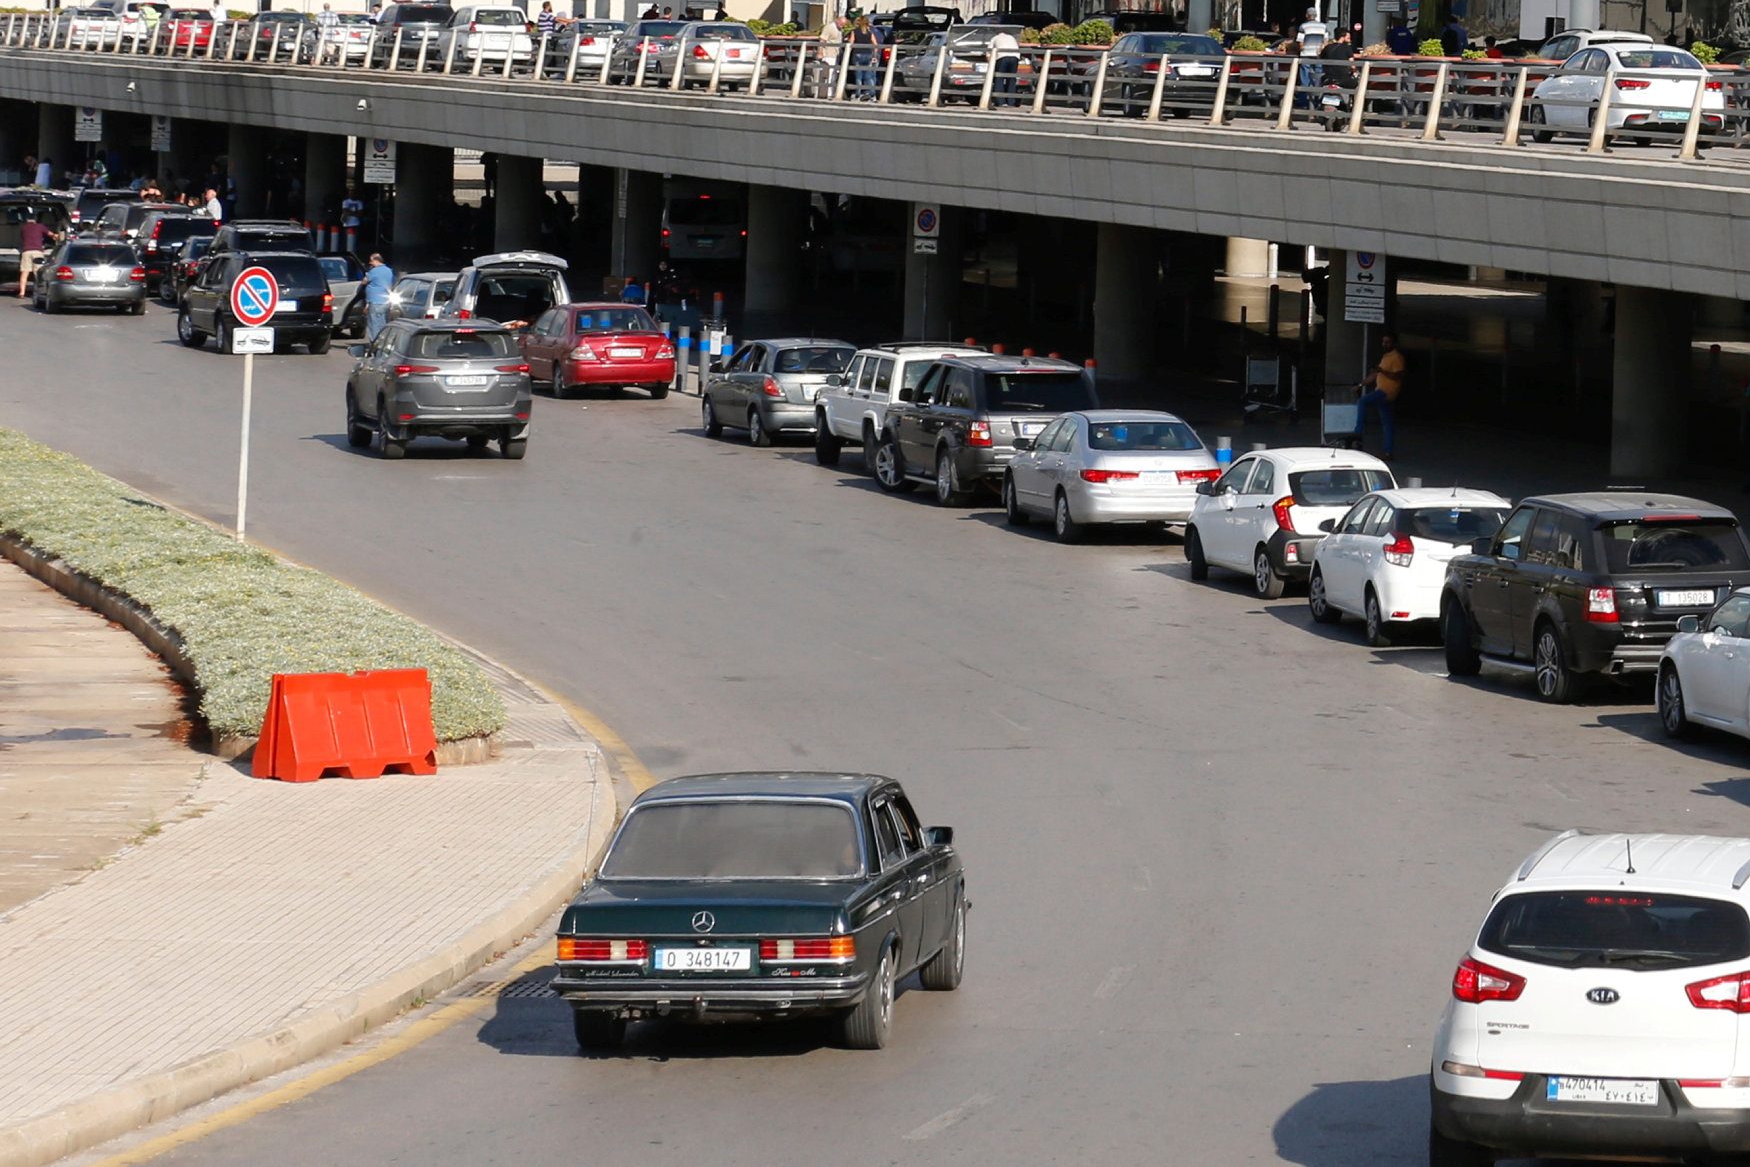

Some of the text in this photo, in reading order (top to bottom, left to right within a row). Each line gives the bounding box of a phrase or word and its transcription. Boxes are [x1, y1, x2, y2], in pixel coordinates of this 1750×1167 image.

[1678, 593, 1708, 603] 135028
[686, 951, 740, 967] 348147
[1590, 990, 1616, 1002] KIA
[1486, 1021, 1530, 1030] SPORTAGE
[1565, 1077, 1606, 1091] 470414
